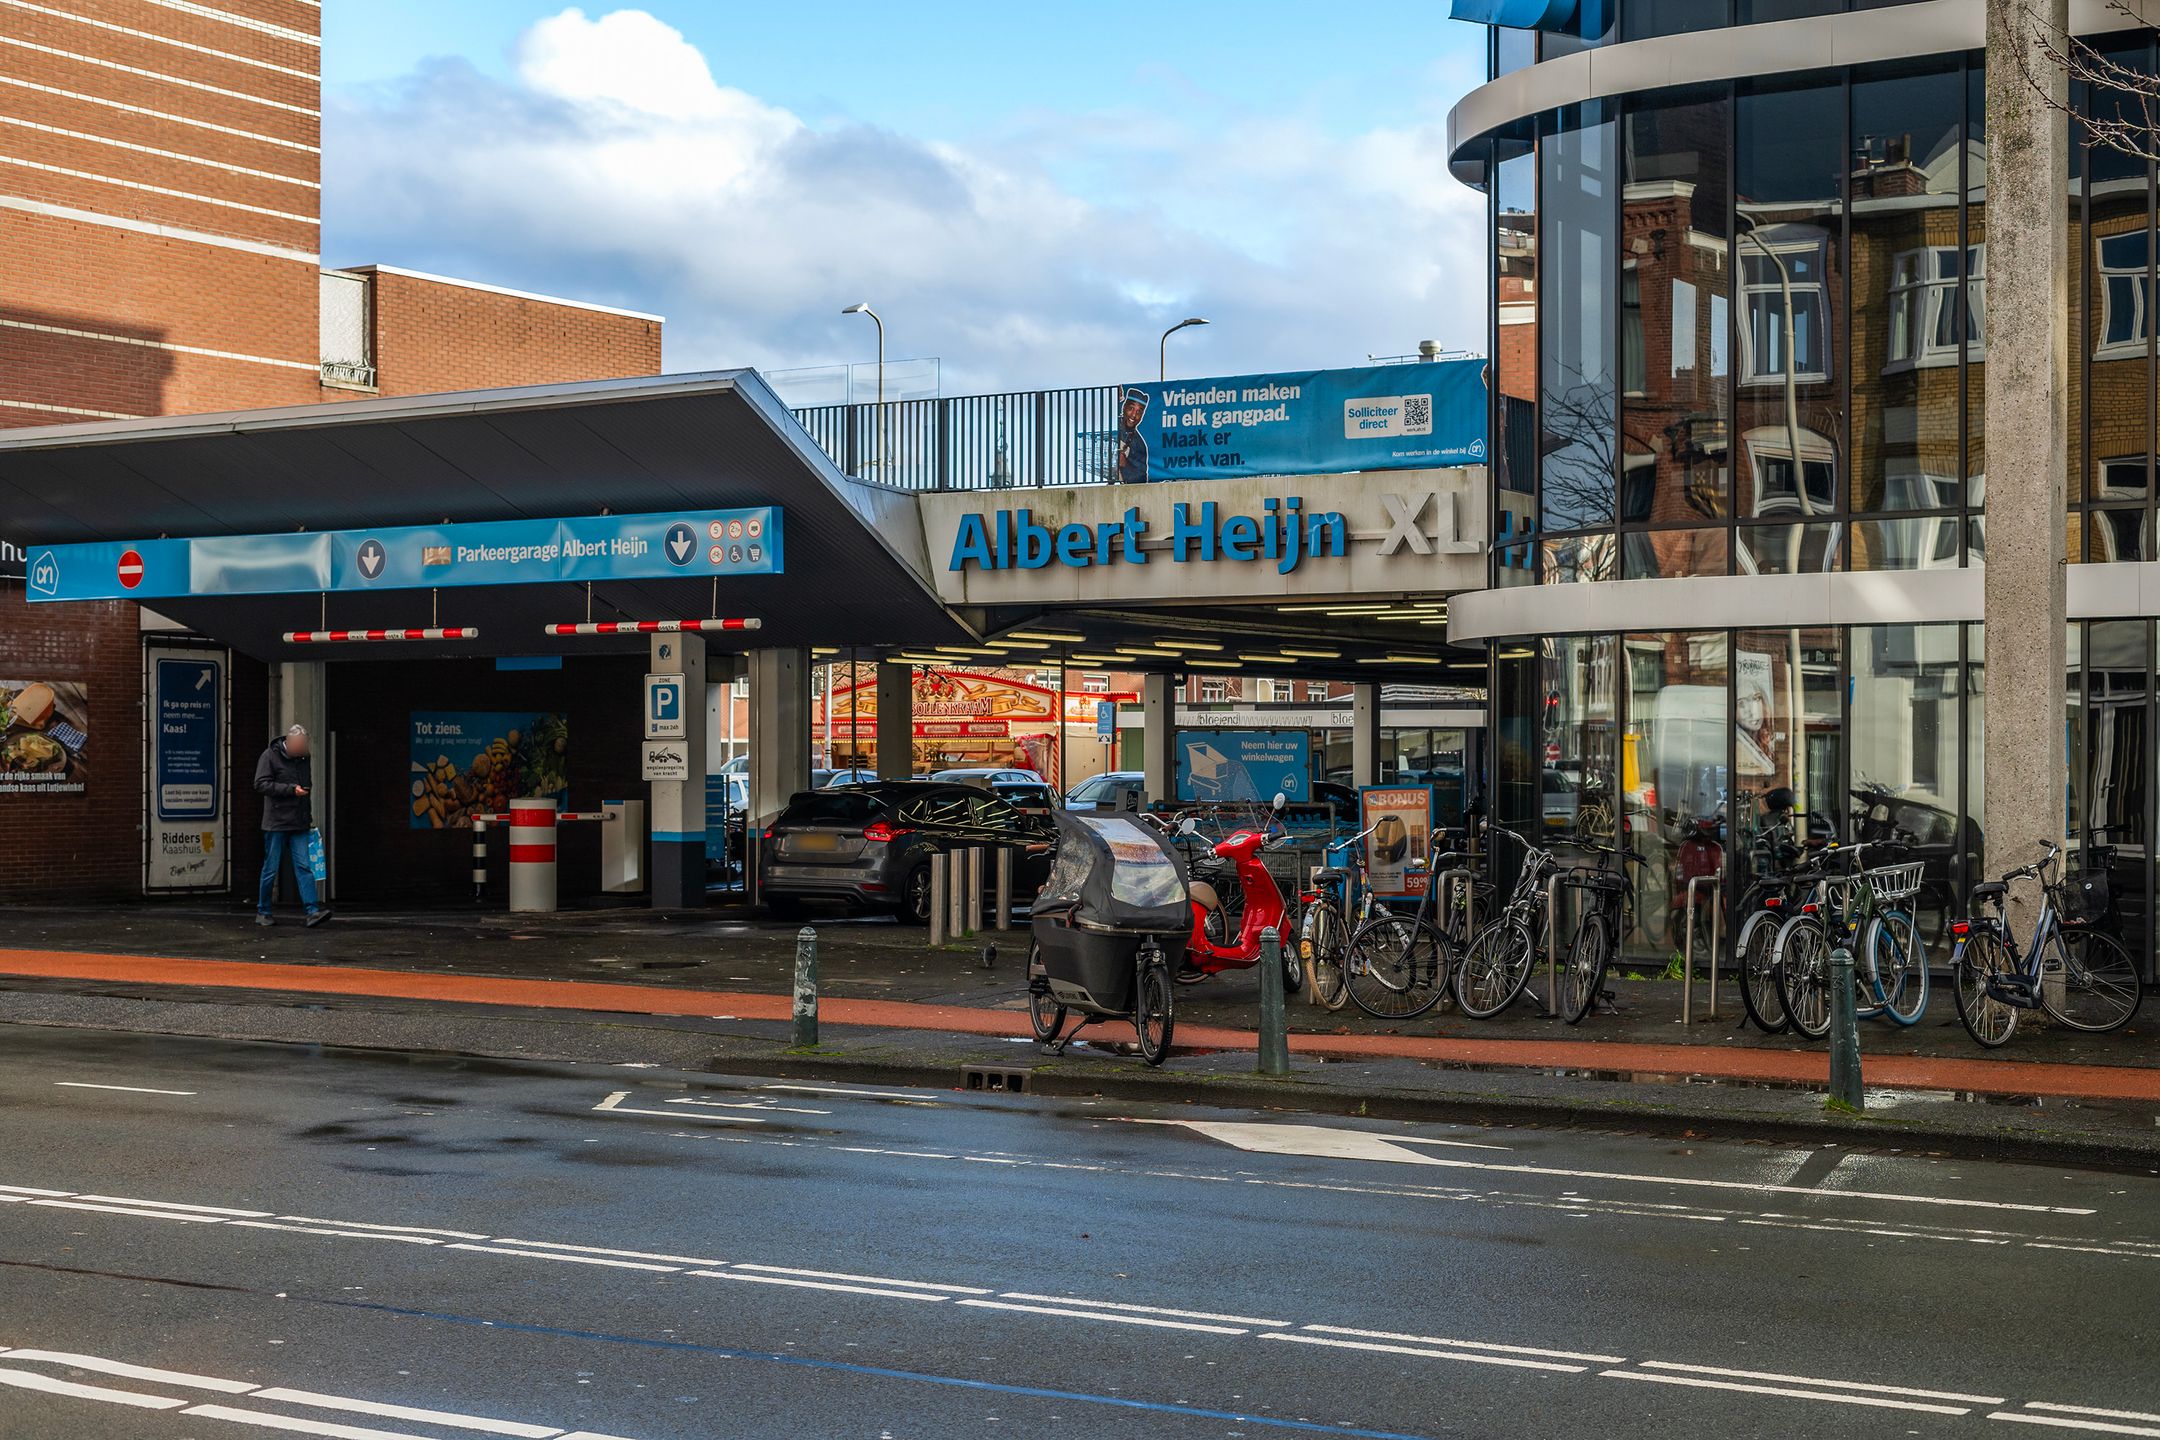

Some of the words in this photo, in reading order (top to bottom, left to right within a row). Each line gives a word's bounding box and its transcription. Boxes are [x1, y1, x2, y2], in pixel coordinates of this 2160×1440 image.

[1163, 386, 1236, 407] Vrienden
[1242, 383, 1300, 402] maken
[1162, 411, 1177, 428] in
[1182, 408, 1207, 426] elk
[1212, 403, 1290, 429] gangpad.
[1348, 406, 1398, 418] Solliciteer
[1359, 419, 1388, 429] direct
[1162, 430, 1208, 449] Maak
[1214, 431, 1231, 446] er
[1163, 451, 1205, 469] werk
[1210, 451, 1245, 467] van.
[948, 506, 1150, 572] Albert
[1173, 496, 1348, 575] Heijn
[1376, 492, 1481, 556] XL
[457, 543, 559, 564] Parkeergarage
[562, 537, 607, 557] Albert
[611, 536, 648, 558] Heijn
[170, 702, 179, 710] ga
[180, 702, 189, 710] op
[190, 700, 202, 709] reis
[657, 688, 673, 717] P
[163, 723, 187, 734] Kaas!
[415, 721, 432, 734] Tot
[435, 721, 463, 735] ziens.
[1241, 741, 1265, 750] Neem
[1267, 740, 1283, 749] hier
[1241, 753, 1294, 763] winkelwagen
[1378, 792, 1426, 805] BONUS
[162, 832, 200, 844] Ridders
[162, 844, 202, 854] Kaashuis
